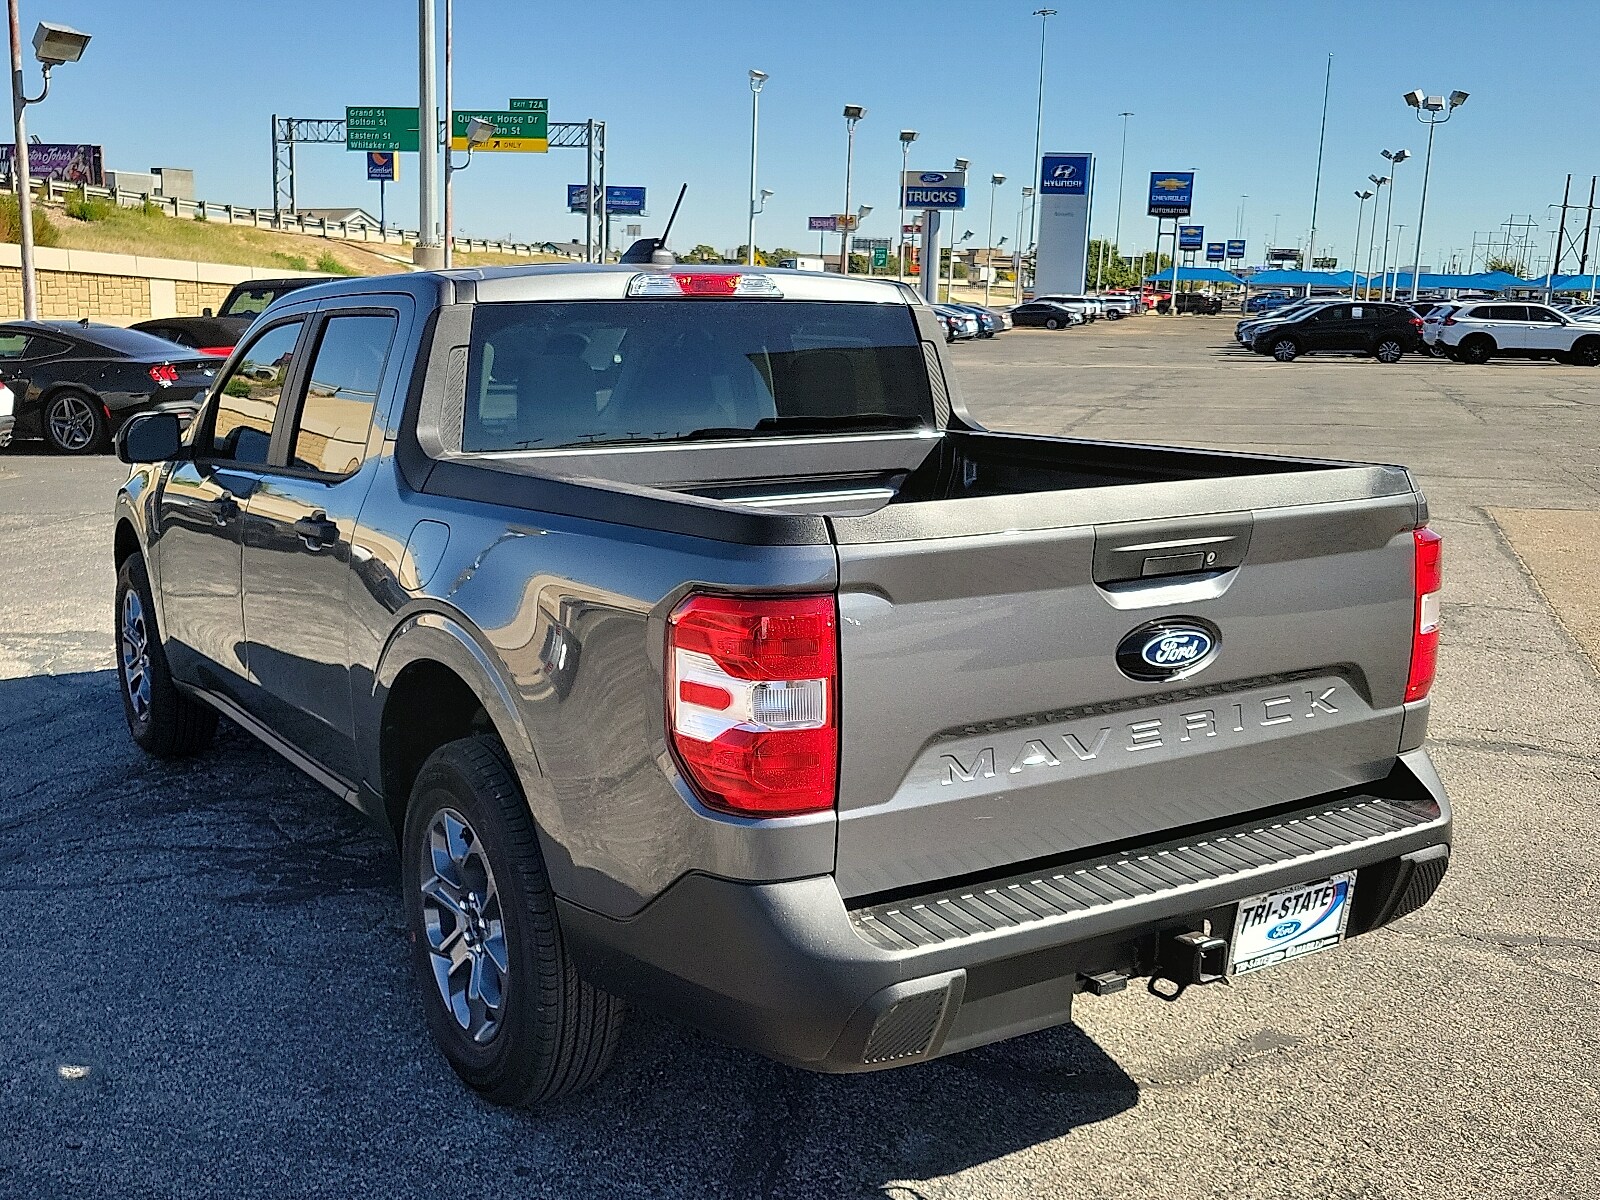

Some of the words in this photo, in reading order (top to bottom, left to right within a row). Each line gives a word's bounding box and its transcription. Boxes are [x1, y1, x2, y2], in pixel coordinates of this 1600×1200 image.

[529, 101, 544, 109] 72A
[349, 109, 374, 117] Grand
[376, 109, 385, 117] St
[349, 118, 376, 126] Bolton
[378, 119, 388, 127] St
[457, 114, 493, 124] Quter
[497, 115, 524, 124] Horse
[527, 115, 539, 124] Dr
[510, 126, 521, 135] St
[350, 132, 380, 140] Eastern
[382, 132, 391, 140] St
[350, 141, 386, 149] Whitaker
[1043, 179, 1084, 188] HYUNDAI
[907, 191, 958, 203] TRUCKS
[1151, 194, 1189, 202] CHEVROLET
[1155, 635, 1200, 663] Ford
[940, 686, 1340, 786] MAVERICK
[1241, 886, 1335, 936] TRI-STATE
[1271, 922, 1298, 939] Ford
